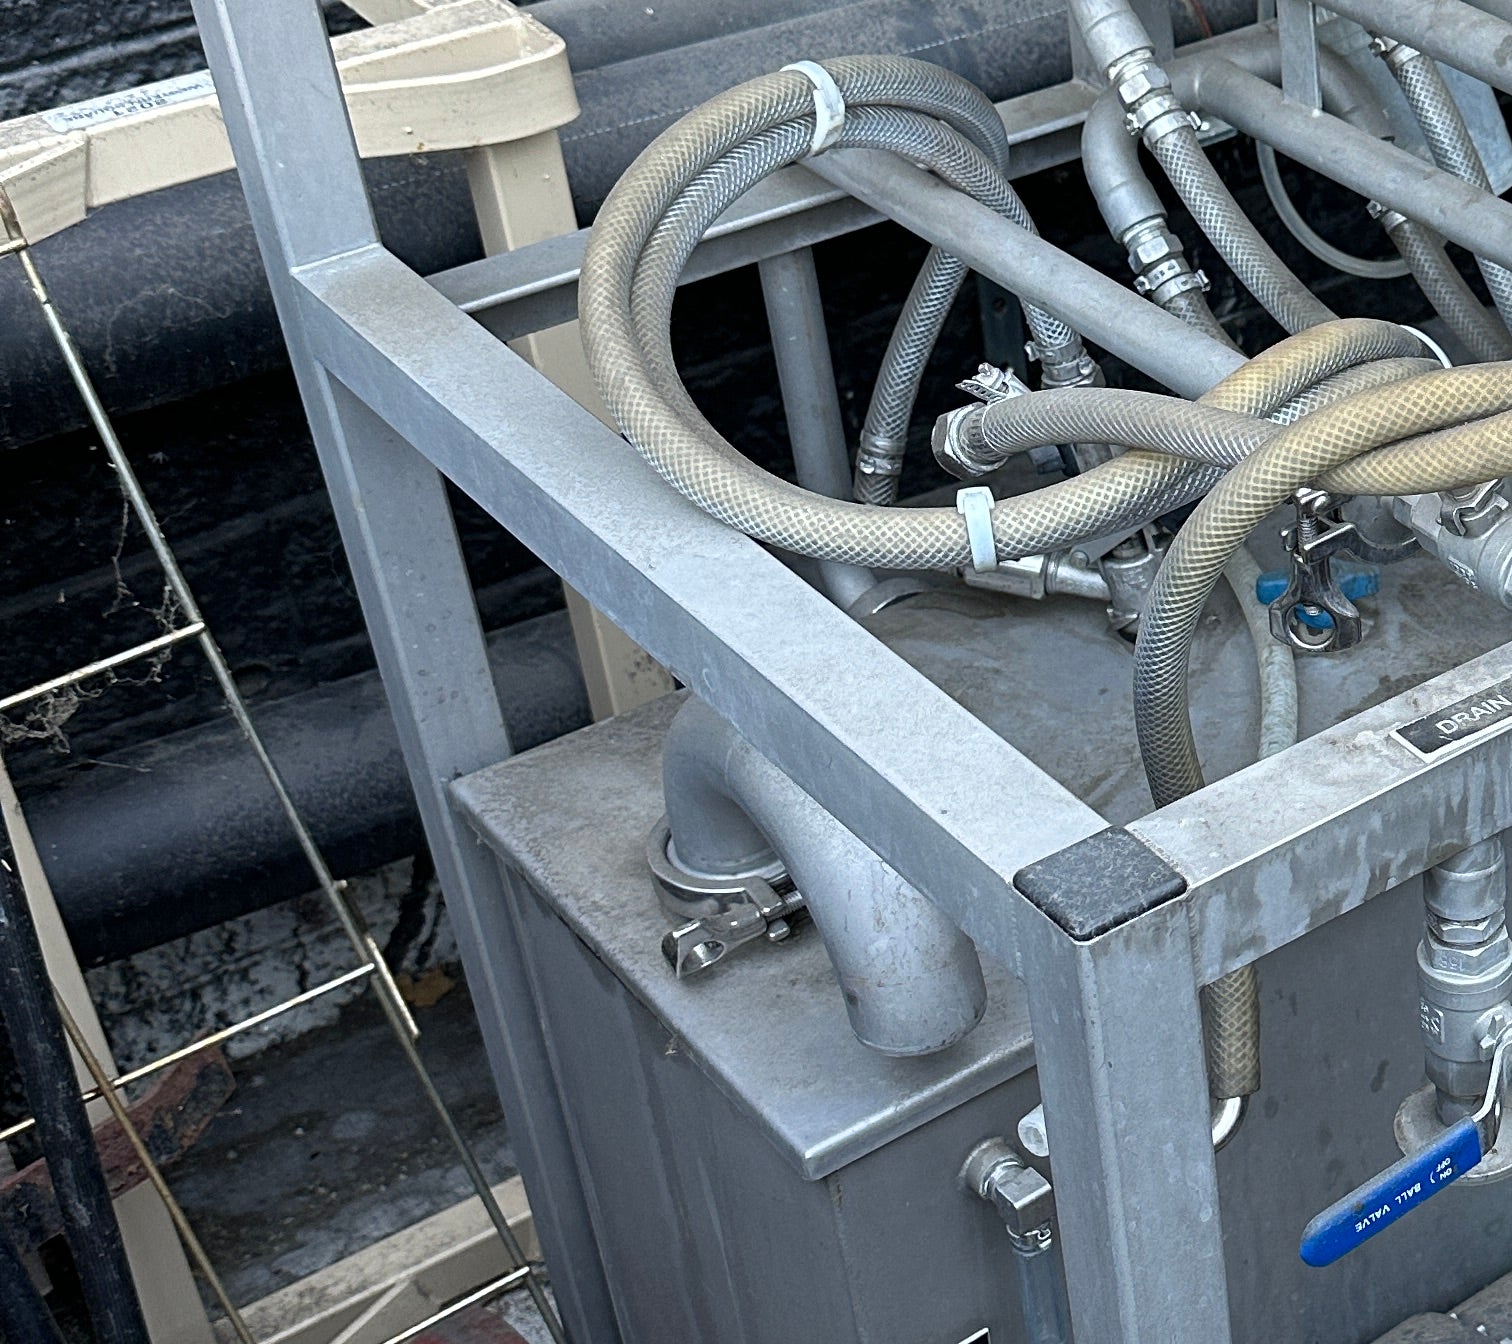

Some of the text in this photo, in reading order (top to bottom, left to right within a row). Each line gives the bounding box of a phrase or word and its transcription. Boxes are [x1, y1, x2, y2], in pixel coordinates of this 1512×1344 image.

[1434, 693, 1512, 737] DRAIN
[1434, 1156, 1452, 1174] OFF
[1438, 1166, 1454, 1182] ON
[1353, 1182, 1423, 1234] BALL VALVE
